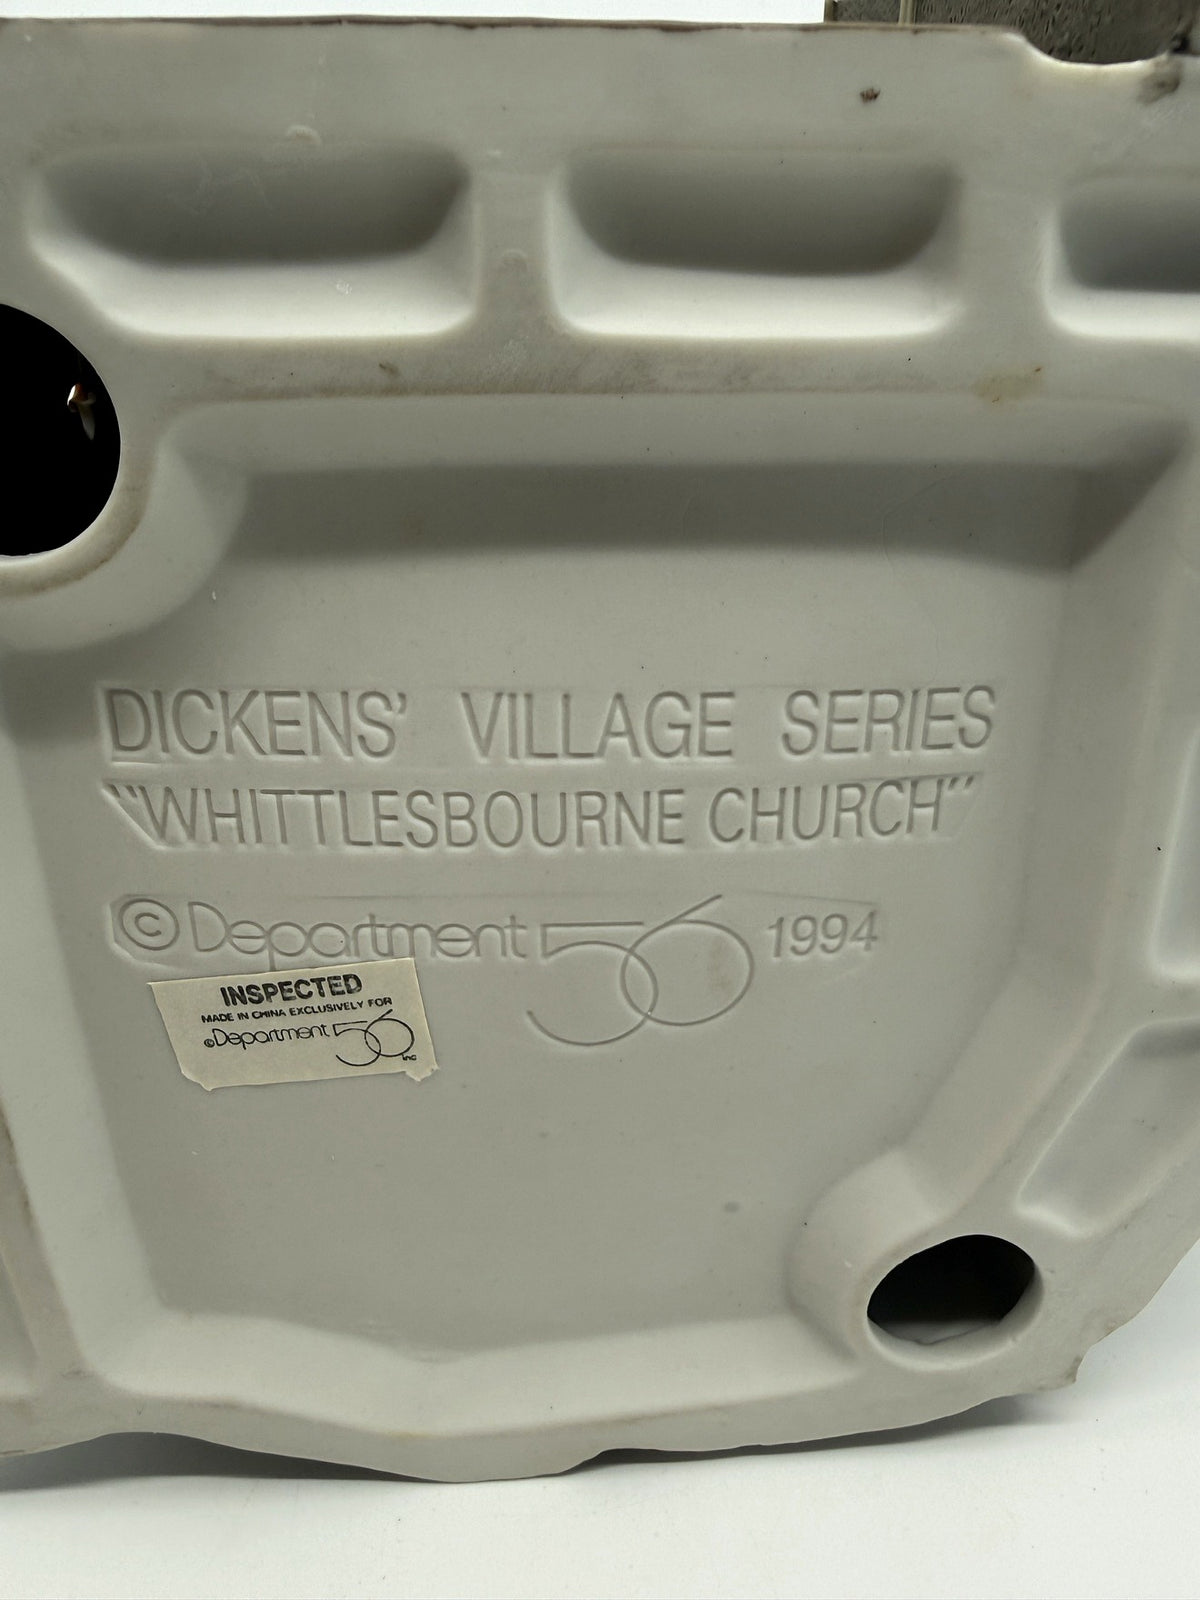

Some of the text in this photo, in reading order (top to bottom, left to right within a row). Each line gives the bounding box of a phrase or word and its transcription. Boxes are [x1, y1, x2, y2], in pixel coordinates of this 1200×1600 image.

[460, 691, 736, 759] VILLAGE
[781, 684, 996, 756] SERIES
[220, 973, 363, 1007] INSPECTED
[526, 894, 755, 1047] 56
[767, 910, 880, 959] 1994
[201, 996, 394, 1024] MADE IN CHINA EXCLUSIVELY FOR
[332, 1008, 415, 1067] 56
